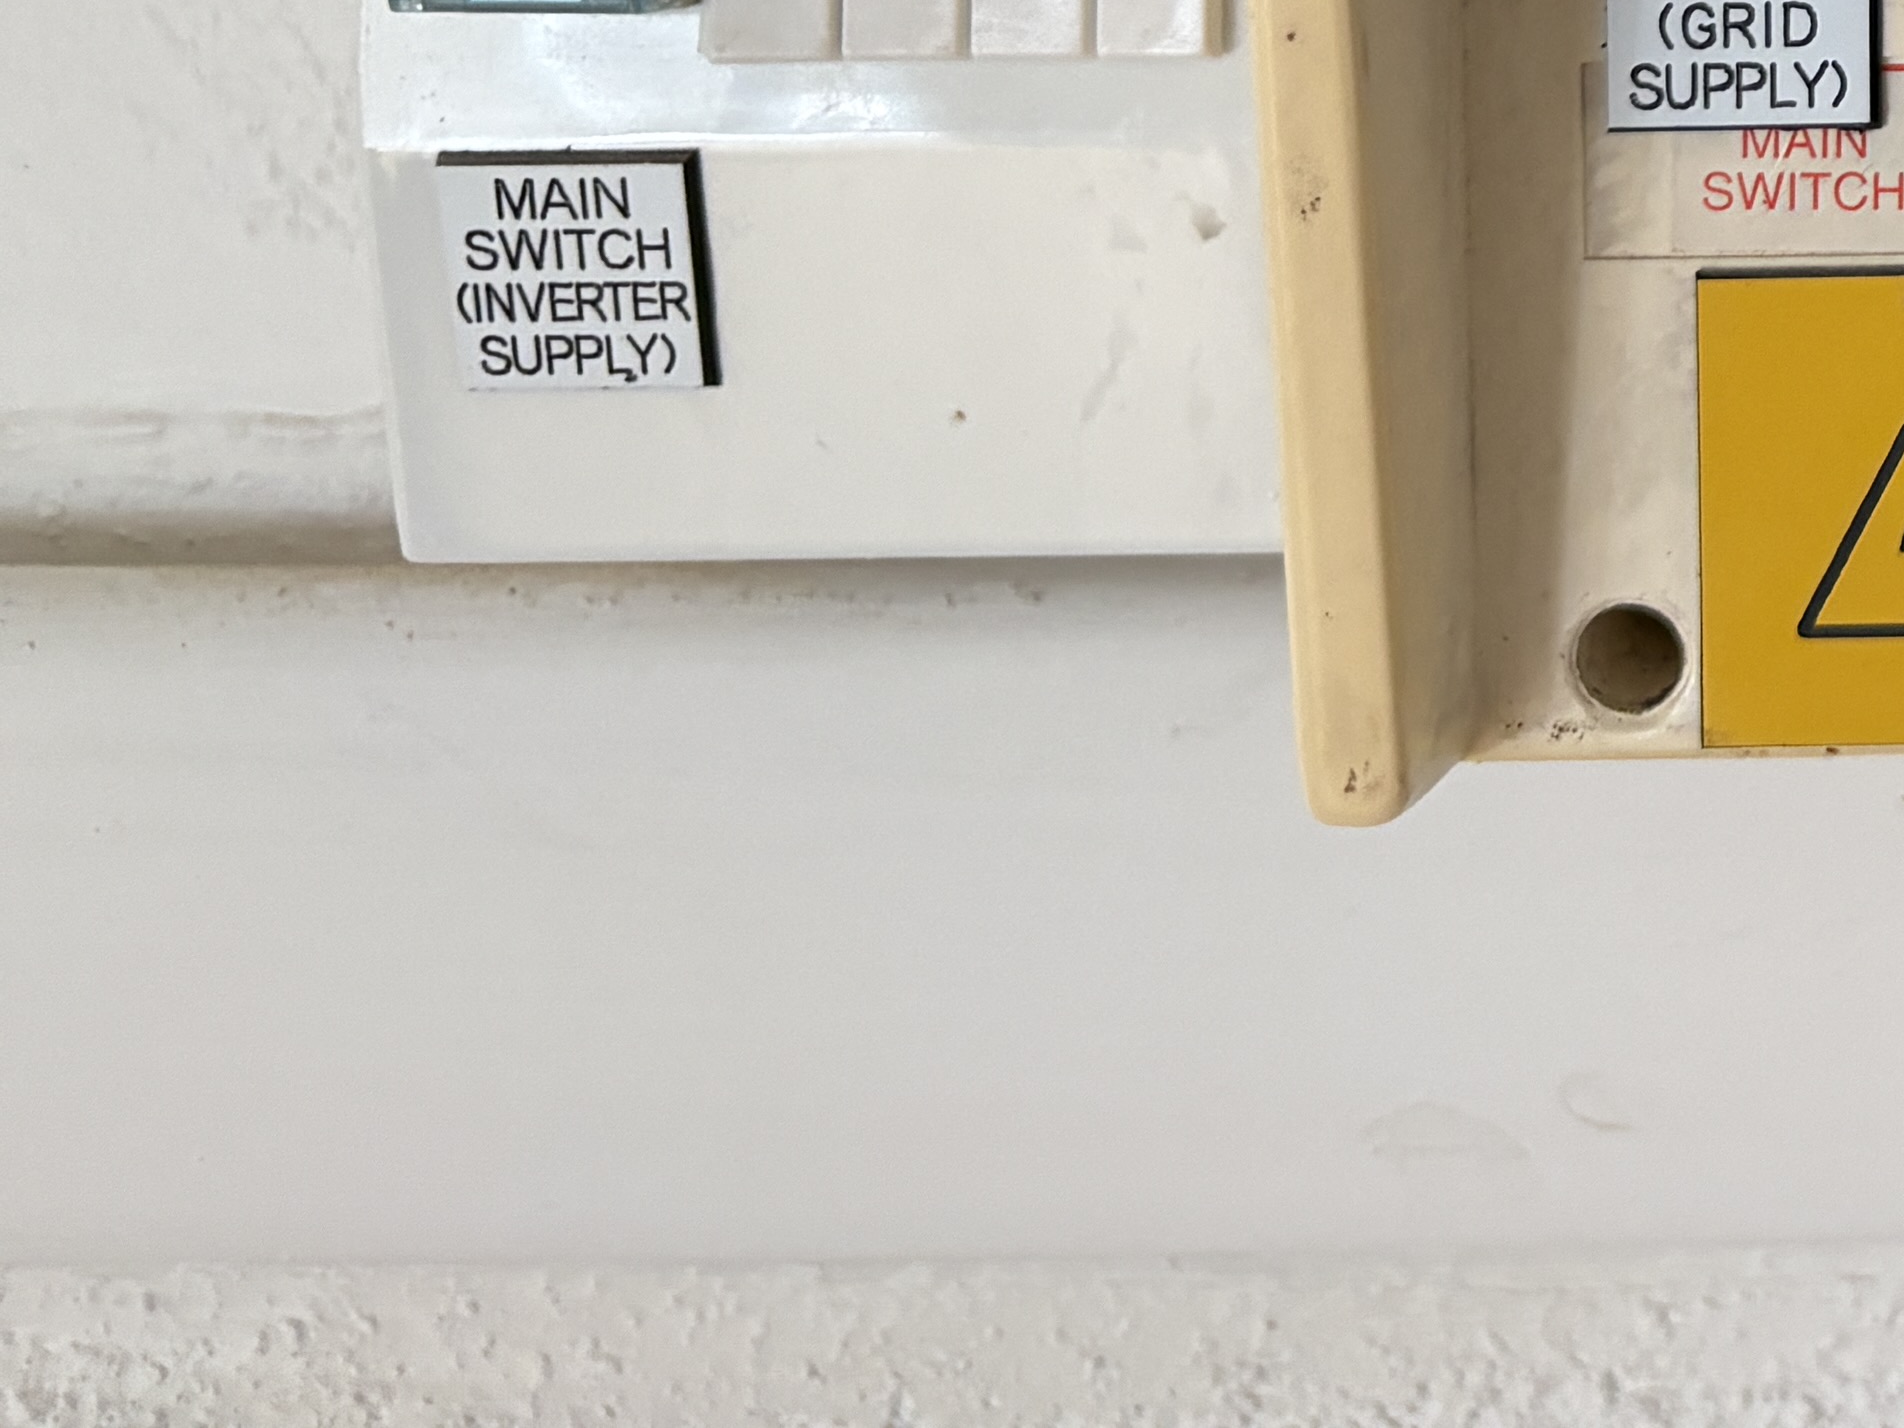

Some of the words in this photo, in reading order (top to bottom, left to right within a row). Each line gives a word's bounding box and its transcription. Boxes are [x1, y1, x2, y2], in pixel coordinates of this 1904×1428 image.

[1658, 1, 1818, 49] (GRID
[1629, 59, 1849, 111] SUPPLY)
[1741, 128, 1867, 159] MAIN
[494, 177, 631, 221] MAIN
[1701, 172, 1904, 212] SWITCH
[465, 227, 672, 271] SWITCH
[457, 281, 691, 324] (INVERTER
[480, 333, 677, 382] SUPPLY)
